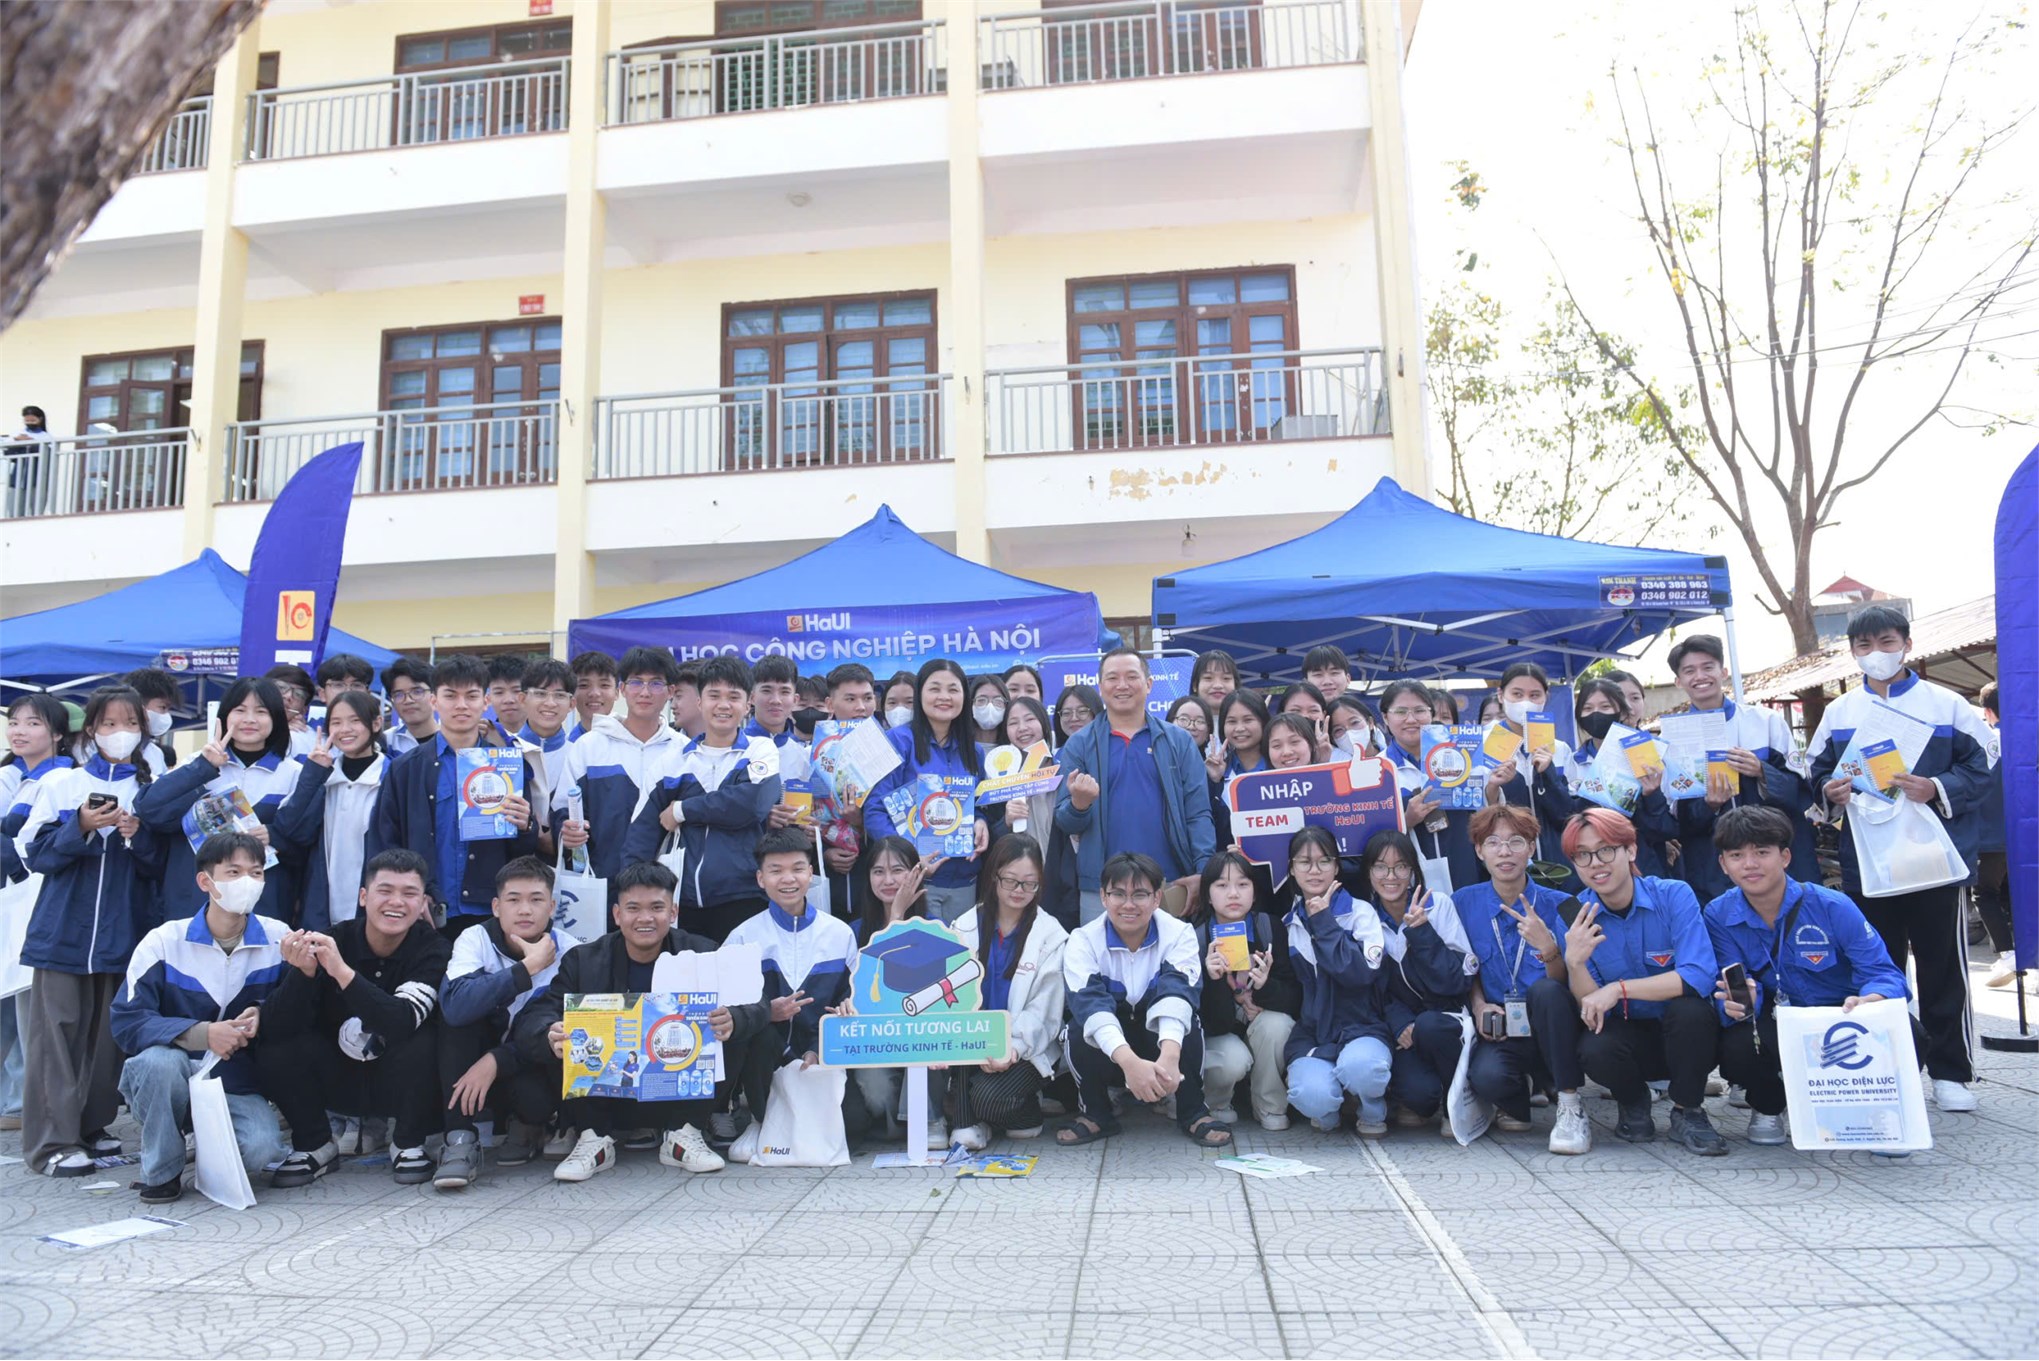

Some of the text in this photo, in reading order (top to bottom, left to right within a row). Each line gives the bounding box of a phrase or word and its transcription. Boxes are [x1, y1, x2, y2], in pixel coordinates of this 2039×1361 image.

[1689, 590, 1708, 599] 012
[805, 612, 850, 632] HaUI
[745, 637, 827, 663] CÔNG
[832, 630, 936, 662] NGHIỆP
[942, 626, 984, 654] HÀ
[990, 624, 1040, 656] NỘI
[1460, 726, 1482, 735] HaUI
[499, 749, 522, 758] HaUI
[952, 777, 972, 786] HaUI
[1260, 779, 1313, 800] NHẬP
[1304, 796, 1394, 815] TRƯỜNG KINH TẾ
[1246, 814, 1288, 828] TEAM
[1334, 814, 1366, 826] HaUI
[690, 994, 716, 1004] HaUI
[840, 1020, 990, 1037] KẾT NỐI TƯƠNG LAI
[844, 1045, 861, 1057] TẠI
[863, 1042, 909, 1054] TRƯỜNG
[912, 1042, 938, 1052] KINH
[942, 1040, 952, 1050] TẾ
[961, 1040, 986, 1050] HaUI
[1808, 1076, 1895, 1088] ĐẠI HỌC ĐIỆN LỰC
